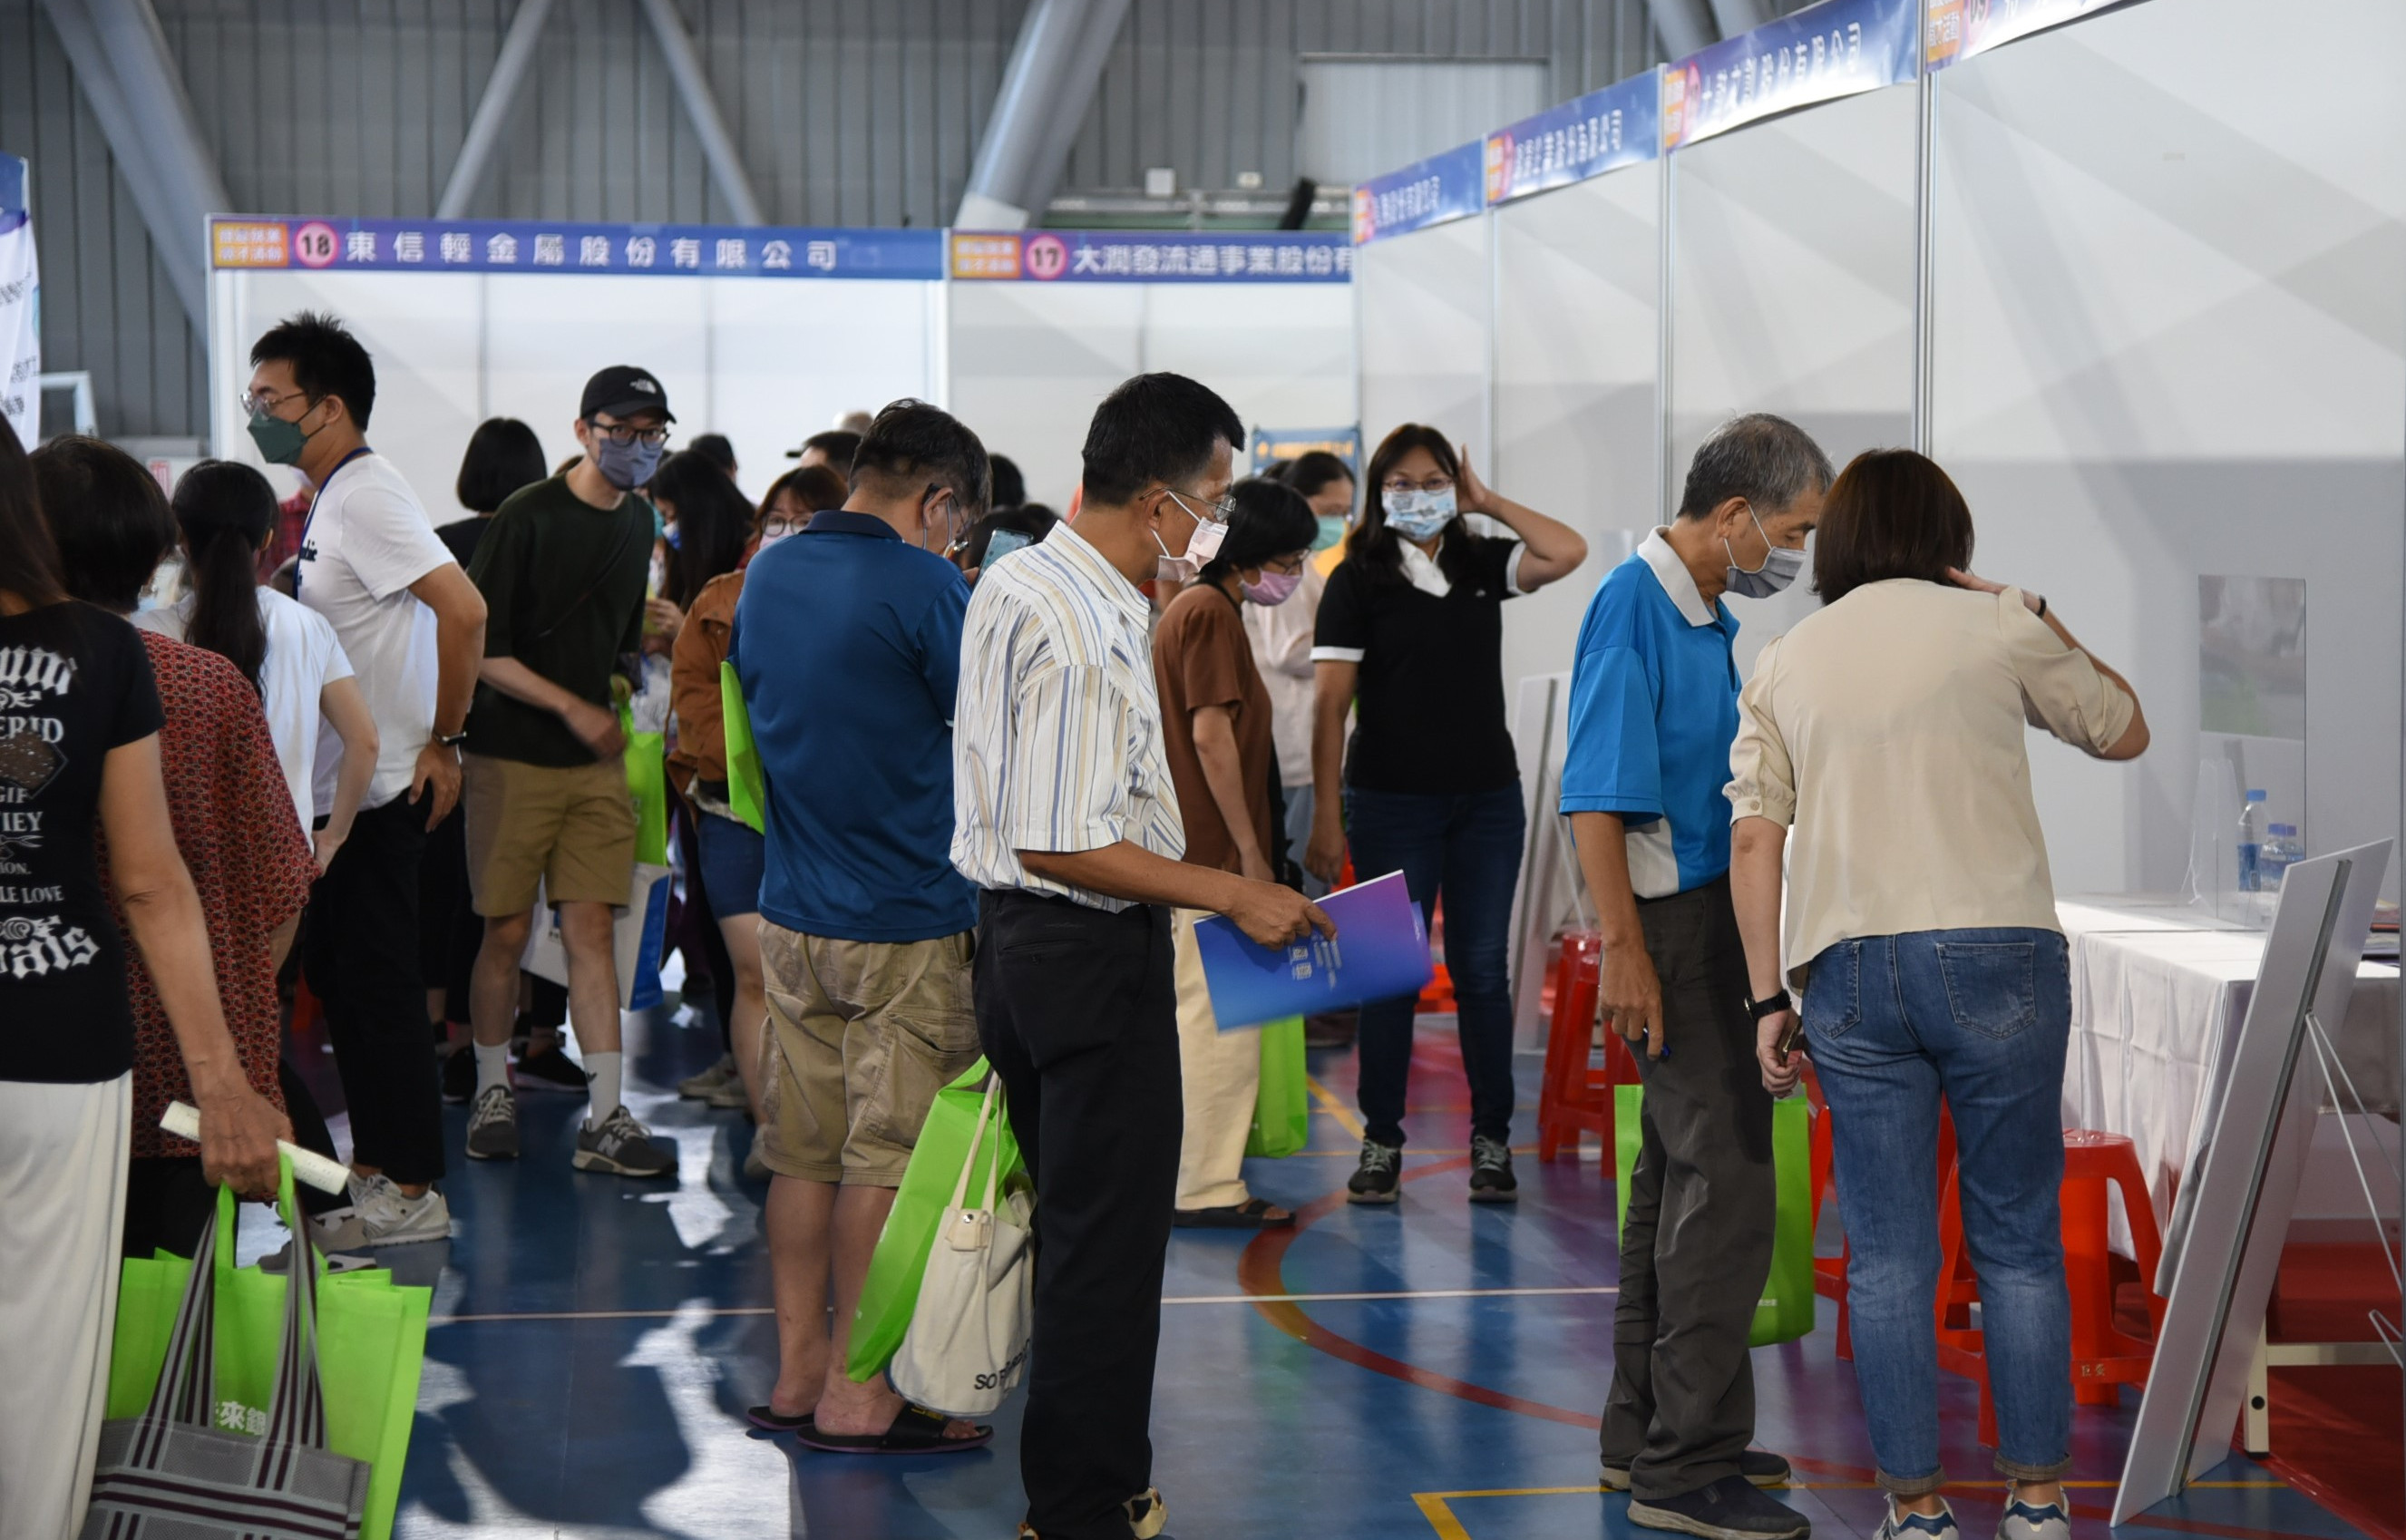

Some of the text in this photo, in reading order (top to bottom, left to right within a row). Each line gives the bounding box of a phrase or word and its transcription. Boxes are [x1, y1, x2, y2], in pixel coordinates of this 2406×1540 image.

[301, 233, 331, 258] 18
[346, 230, 837, 271] 東信輕金屬股份有限公司
[1034, 247, 1060, 268] 17
[21, 885, 64, 903] LOVE
